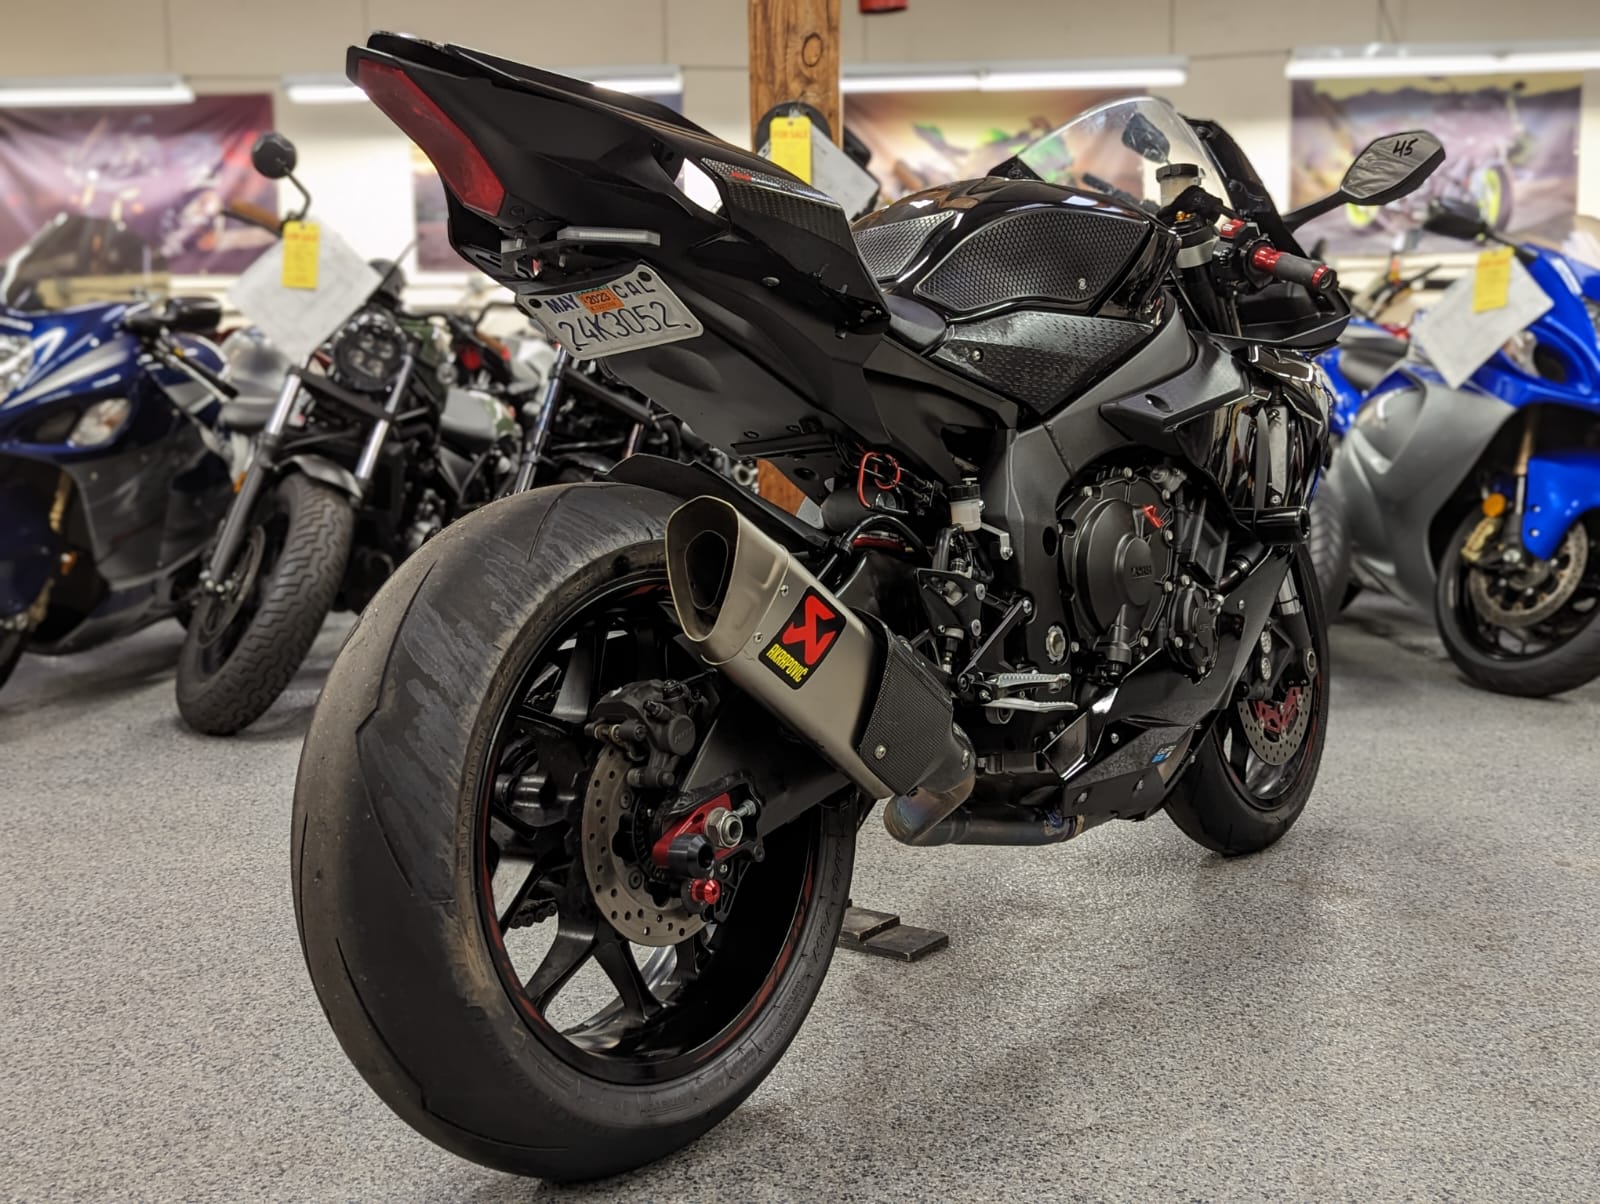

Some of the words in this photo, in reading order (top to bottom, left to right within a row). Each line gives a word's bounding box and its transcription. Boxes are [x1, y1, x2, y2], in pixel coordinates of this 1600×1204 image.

[1392, 138, 1419, 157] 45
[544, 294, 580, 314] MAY
[585, 292, 611, 304] 2023
[611, 279, 656, 299] CAL
[558, 301, 681, 347] 24K3052
